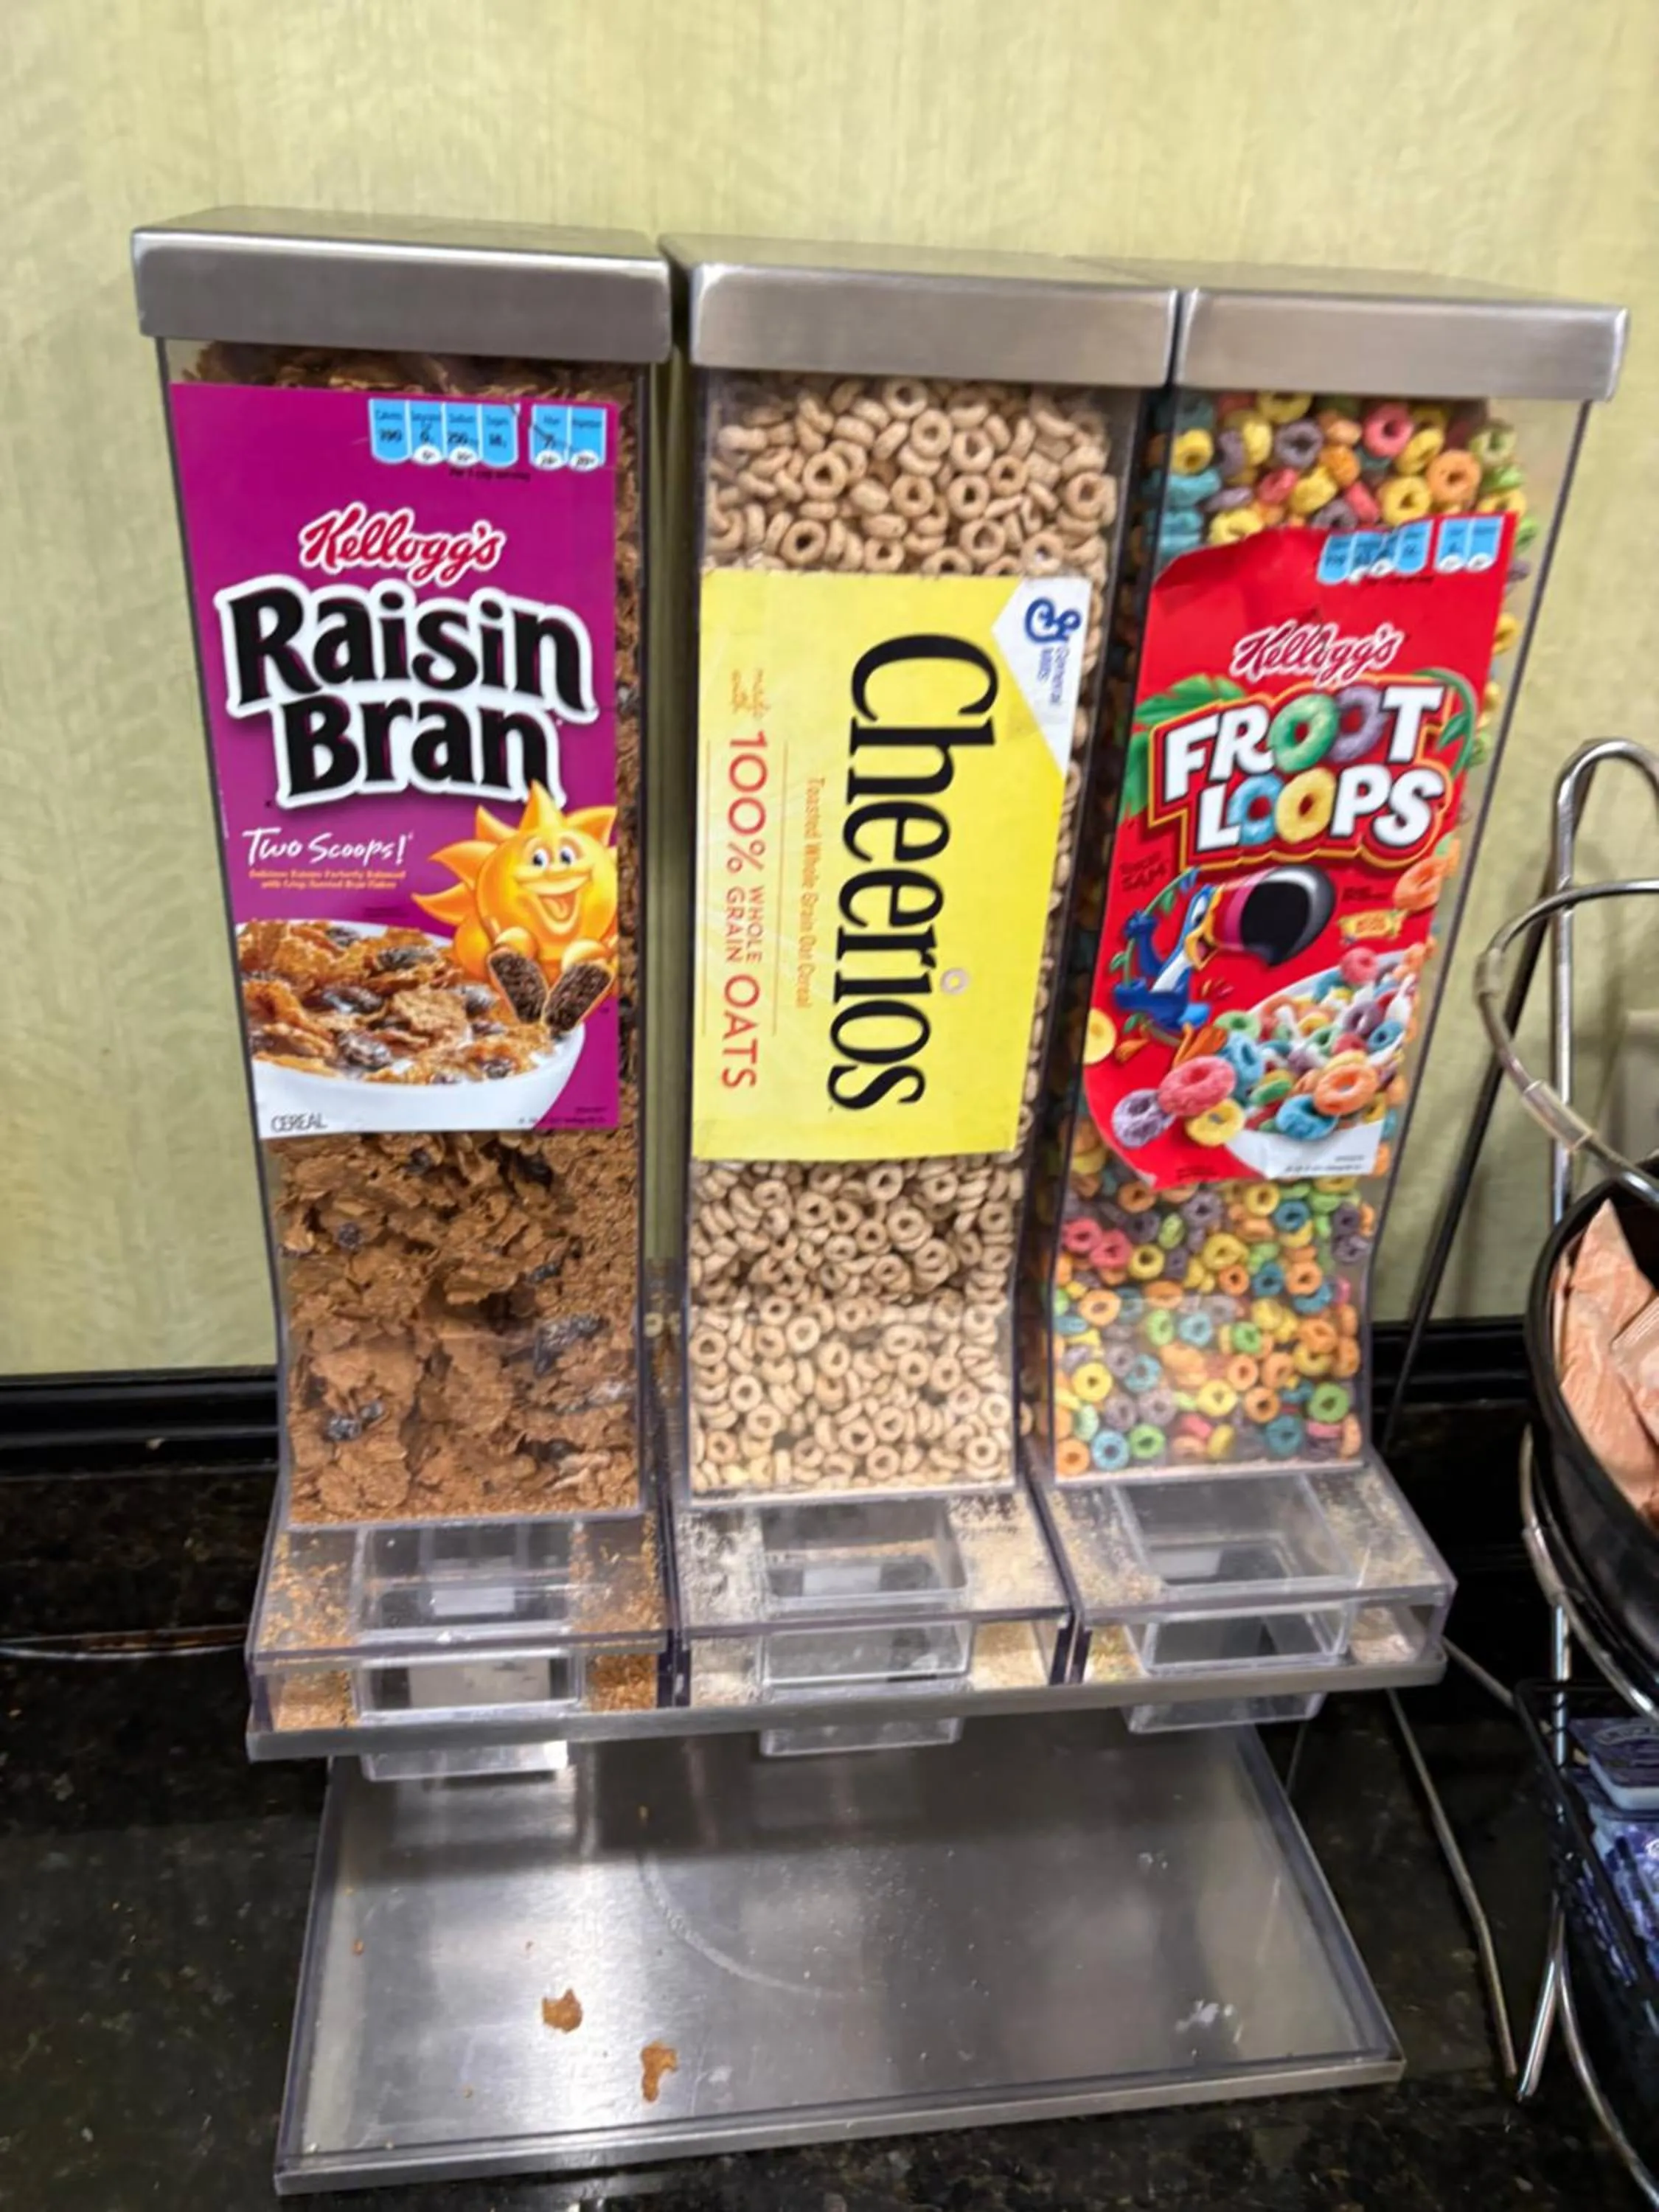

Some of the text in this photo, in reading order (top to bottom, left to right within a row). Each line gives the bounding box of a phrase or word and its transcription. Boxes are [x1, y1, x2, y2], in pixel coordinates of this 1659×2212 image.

[300, 503, 505, 585] Kellogg's
[218, 578, 596, 716] Raisin
[1229, 619, 1404, 685] Kellogg's
[277, 692, 563, 805] Bran
[1163, 684, 1445, 804] FROOT
[726, 729, 768, 874] 100%
[1196, 763, 1445, 852] LOOPS
[242, 827, 407, 866] Two Scoops!
[827, 633, 999, 1111] Cheerios
[726, 886, 745, 964] GRAIN
[745, 885, 764, 964] WHOLE
[720, 973, 761, 1088] OATS
[270, 1111, 329, 1133] CEREAL
